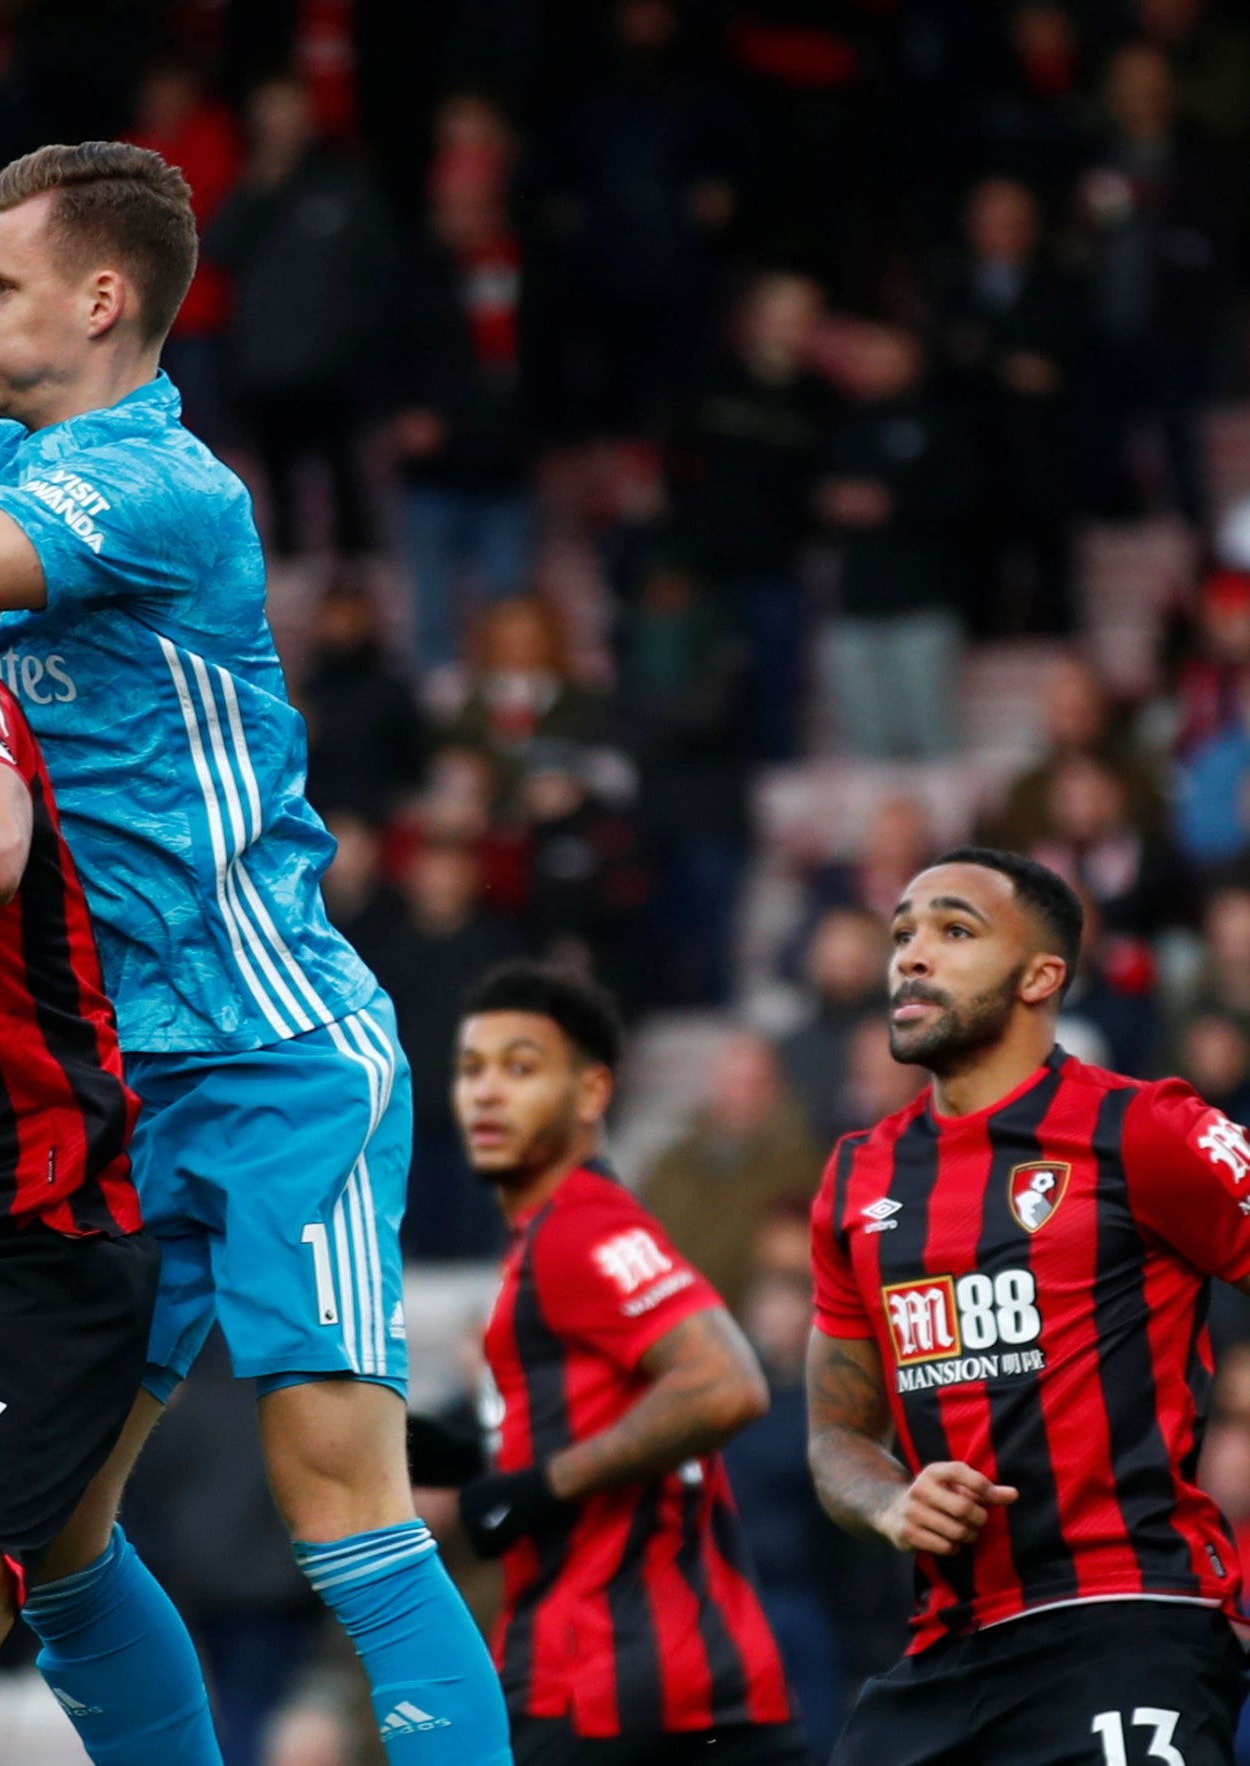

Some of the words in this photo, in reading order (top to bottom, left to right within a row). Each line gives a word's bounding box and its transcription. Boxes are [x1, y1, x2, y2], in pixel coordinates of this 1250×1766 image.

[52, 469, 112, 516] VISIT
[300, 1222, 339, 1326] 1
[898, 1355, 999, 1394] MANSION
[1091, 1706, 1187, 1766] 13
